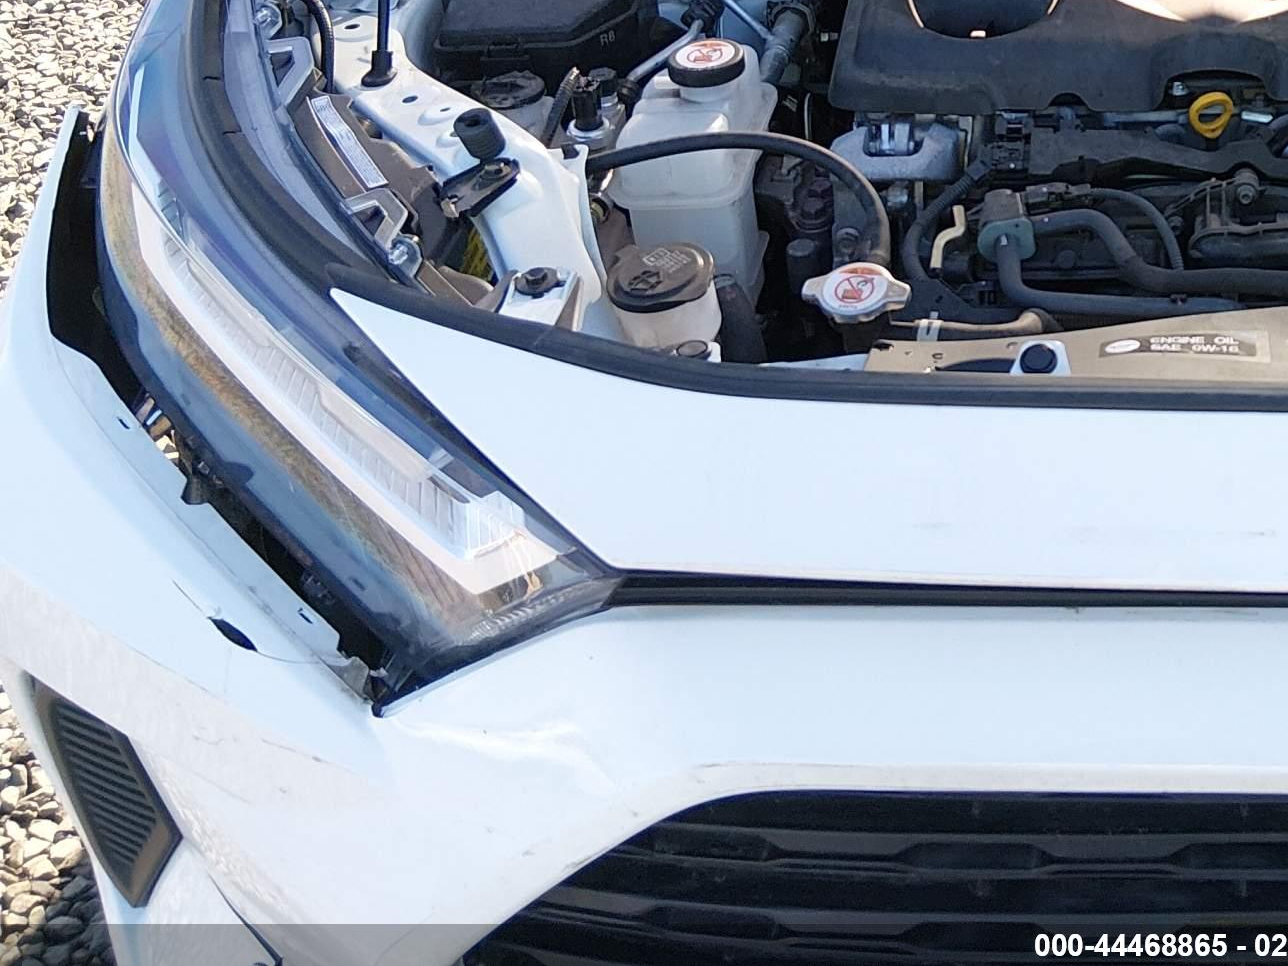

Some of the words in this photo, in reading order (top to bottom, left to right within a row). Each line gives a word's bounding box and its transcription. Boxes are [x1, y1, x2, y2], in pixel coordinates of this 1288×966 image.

[1150, 336, 1205, 345] ENGINE
[1213, 336, 1240, 345] OIL
[1150, 343, 1181, 352] SAE
[1191, 344, 1239, 353] 0W-16
